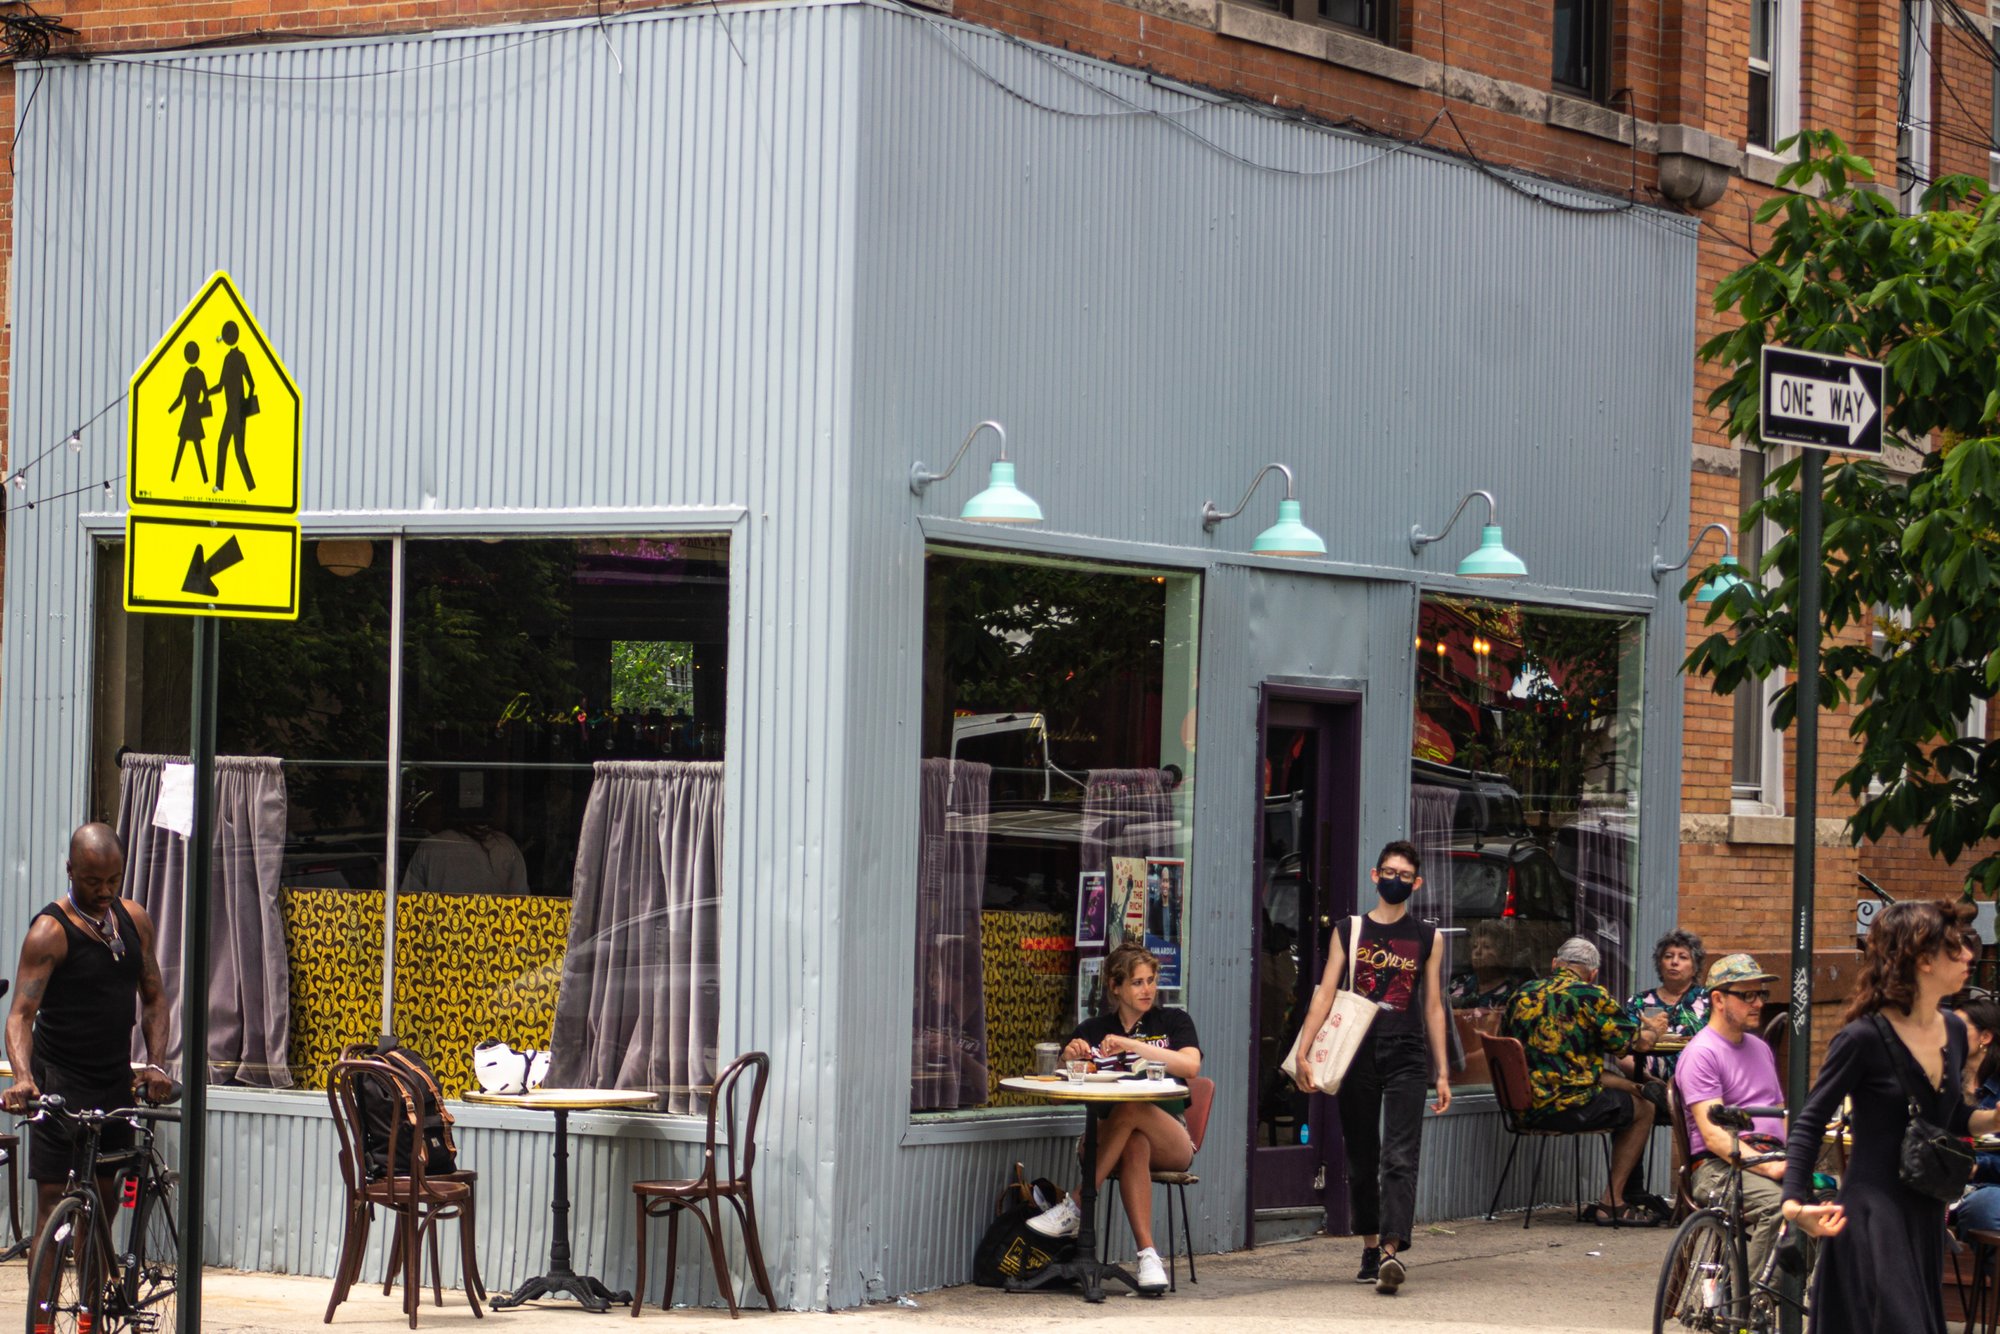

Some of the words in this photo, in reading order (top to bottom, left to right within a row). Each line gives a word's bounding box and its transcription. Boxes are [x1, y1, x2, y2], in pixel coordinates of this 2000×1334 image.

[1780, 380, 1814, 417] ONE
[1829, 387, 1865, 424] WAY
[1134, 880, 1143, 888] TAX
[1132, 891, 1143, 900] THE
[1129, 902, 1143, 911] RICH
